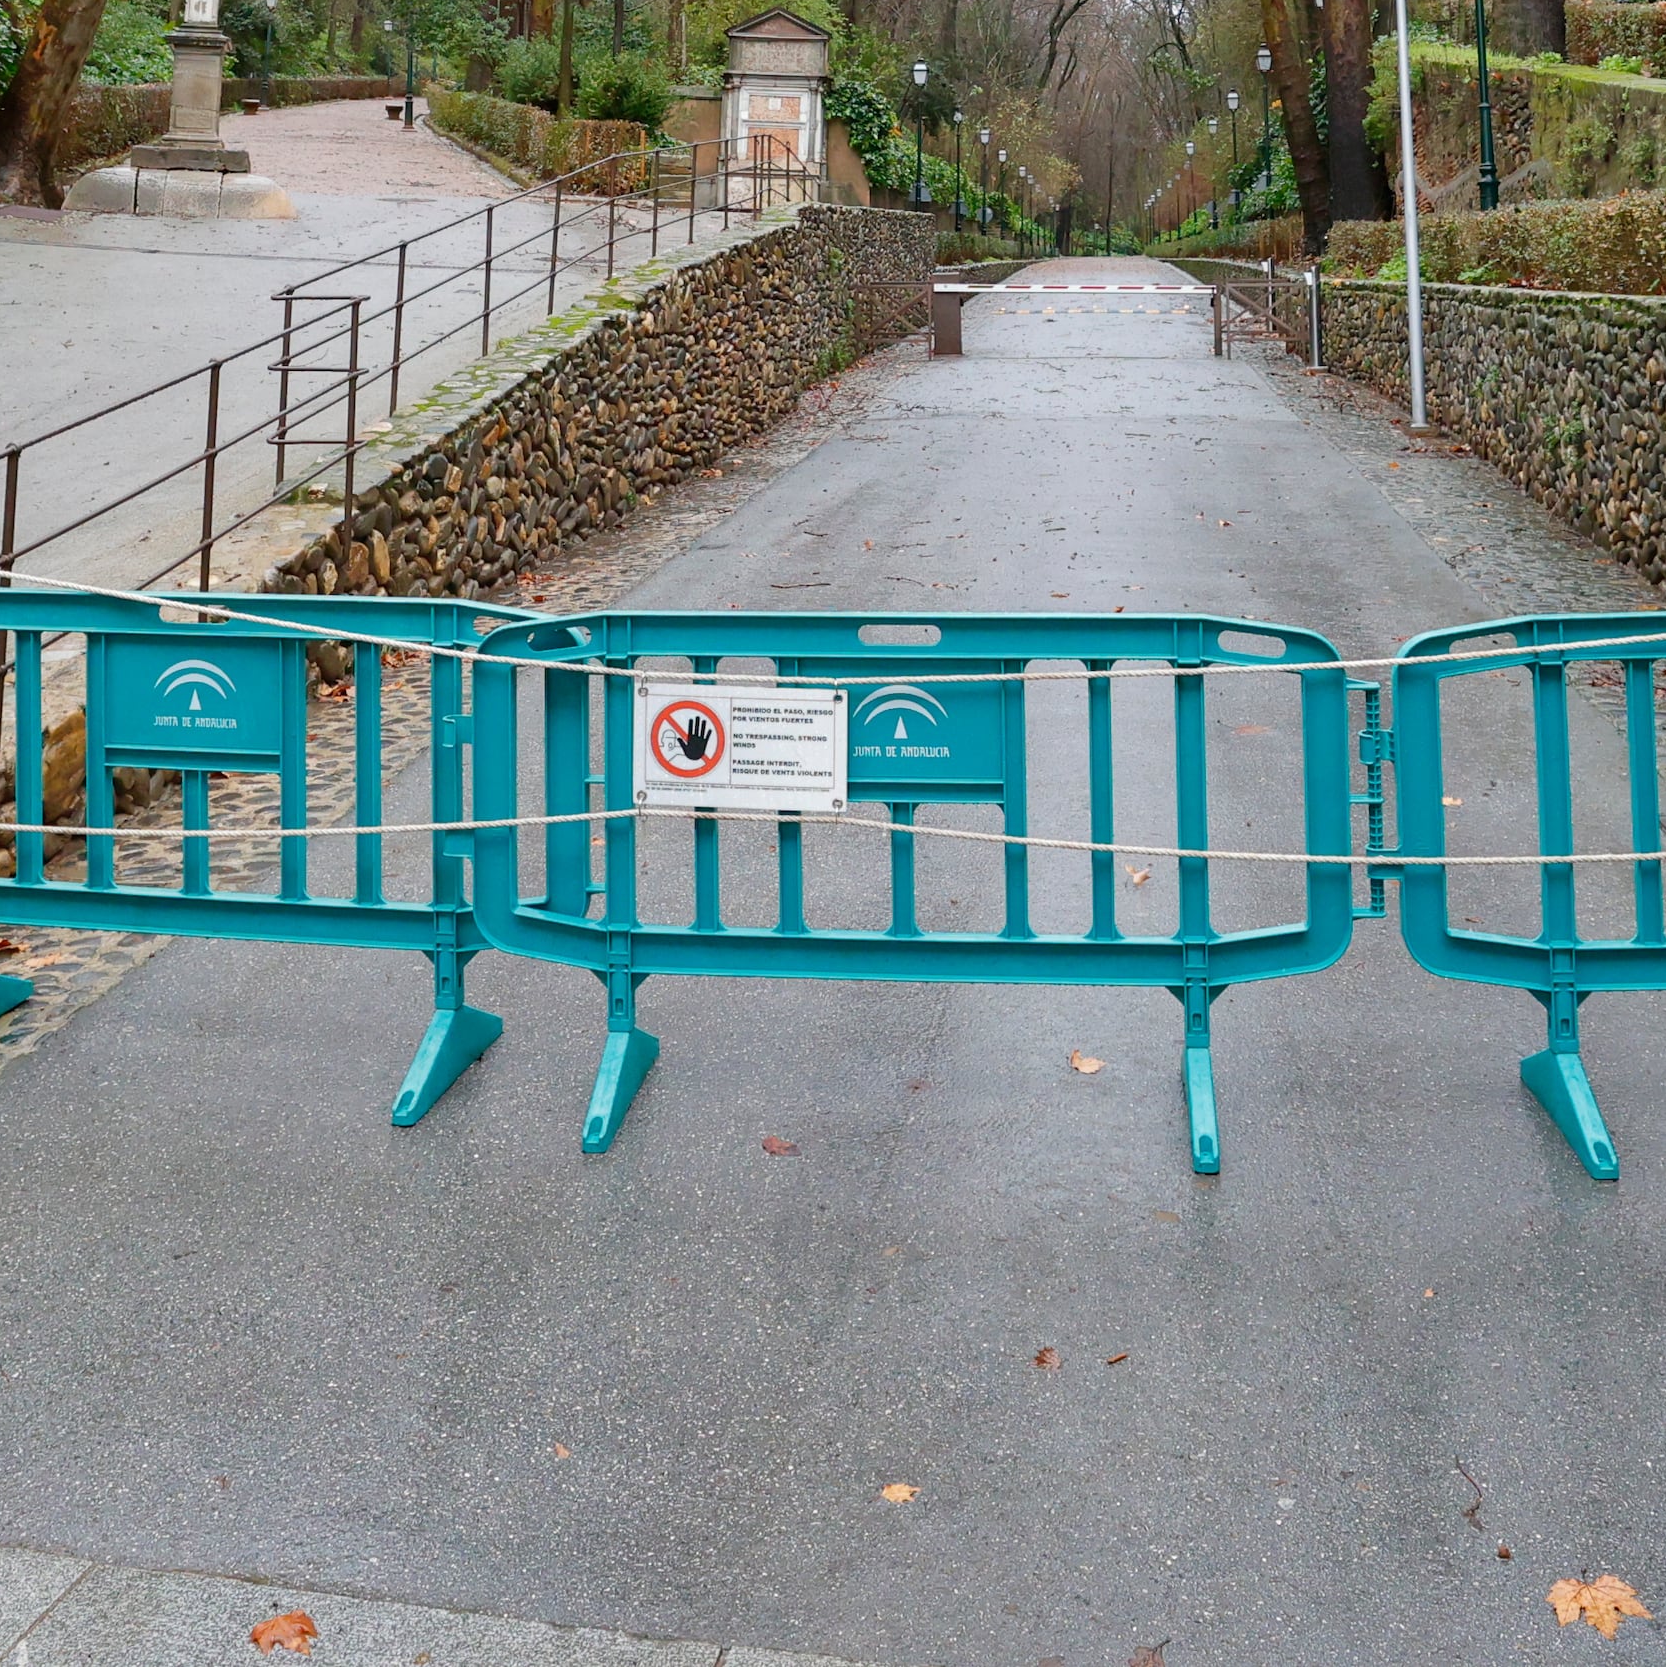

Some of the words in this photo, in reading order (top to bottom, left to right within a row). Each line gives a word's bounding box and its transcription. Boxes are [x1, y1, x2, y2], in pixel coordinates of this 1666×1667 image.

[153, 715, 179, 727] JUNTA
[181, 716, 192, 728] DE
[194, 717, 238, 729] ANDALUCIA
[852, 746, 882, 758] JUNTA
[885, 746, 897, 758] DE
[900, 746, 950, 758] ANDALUCIA
